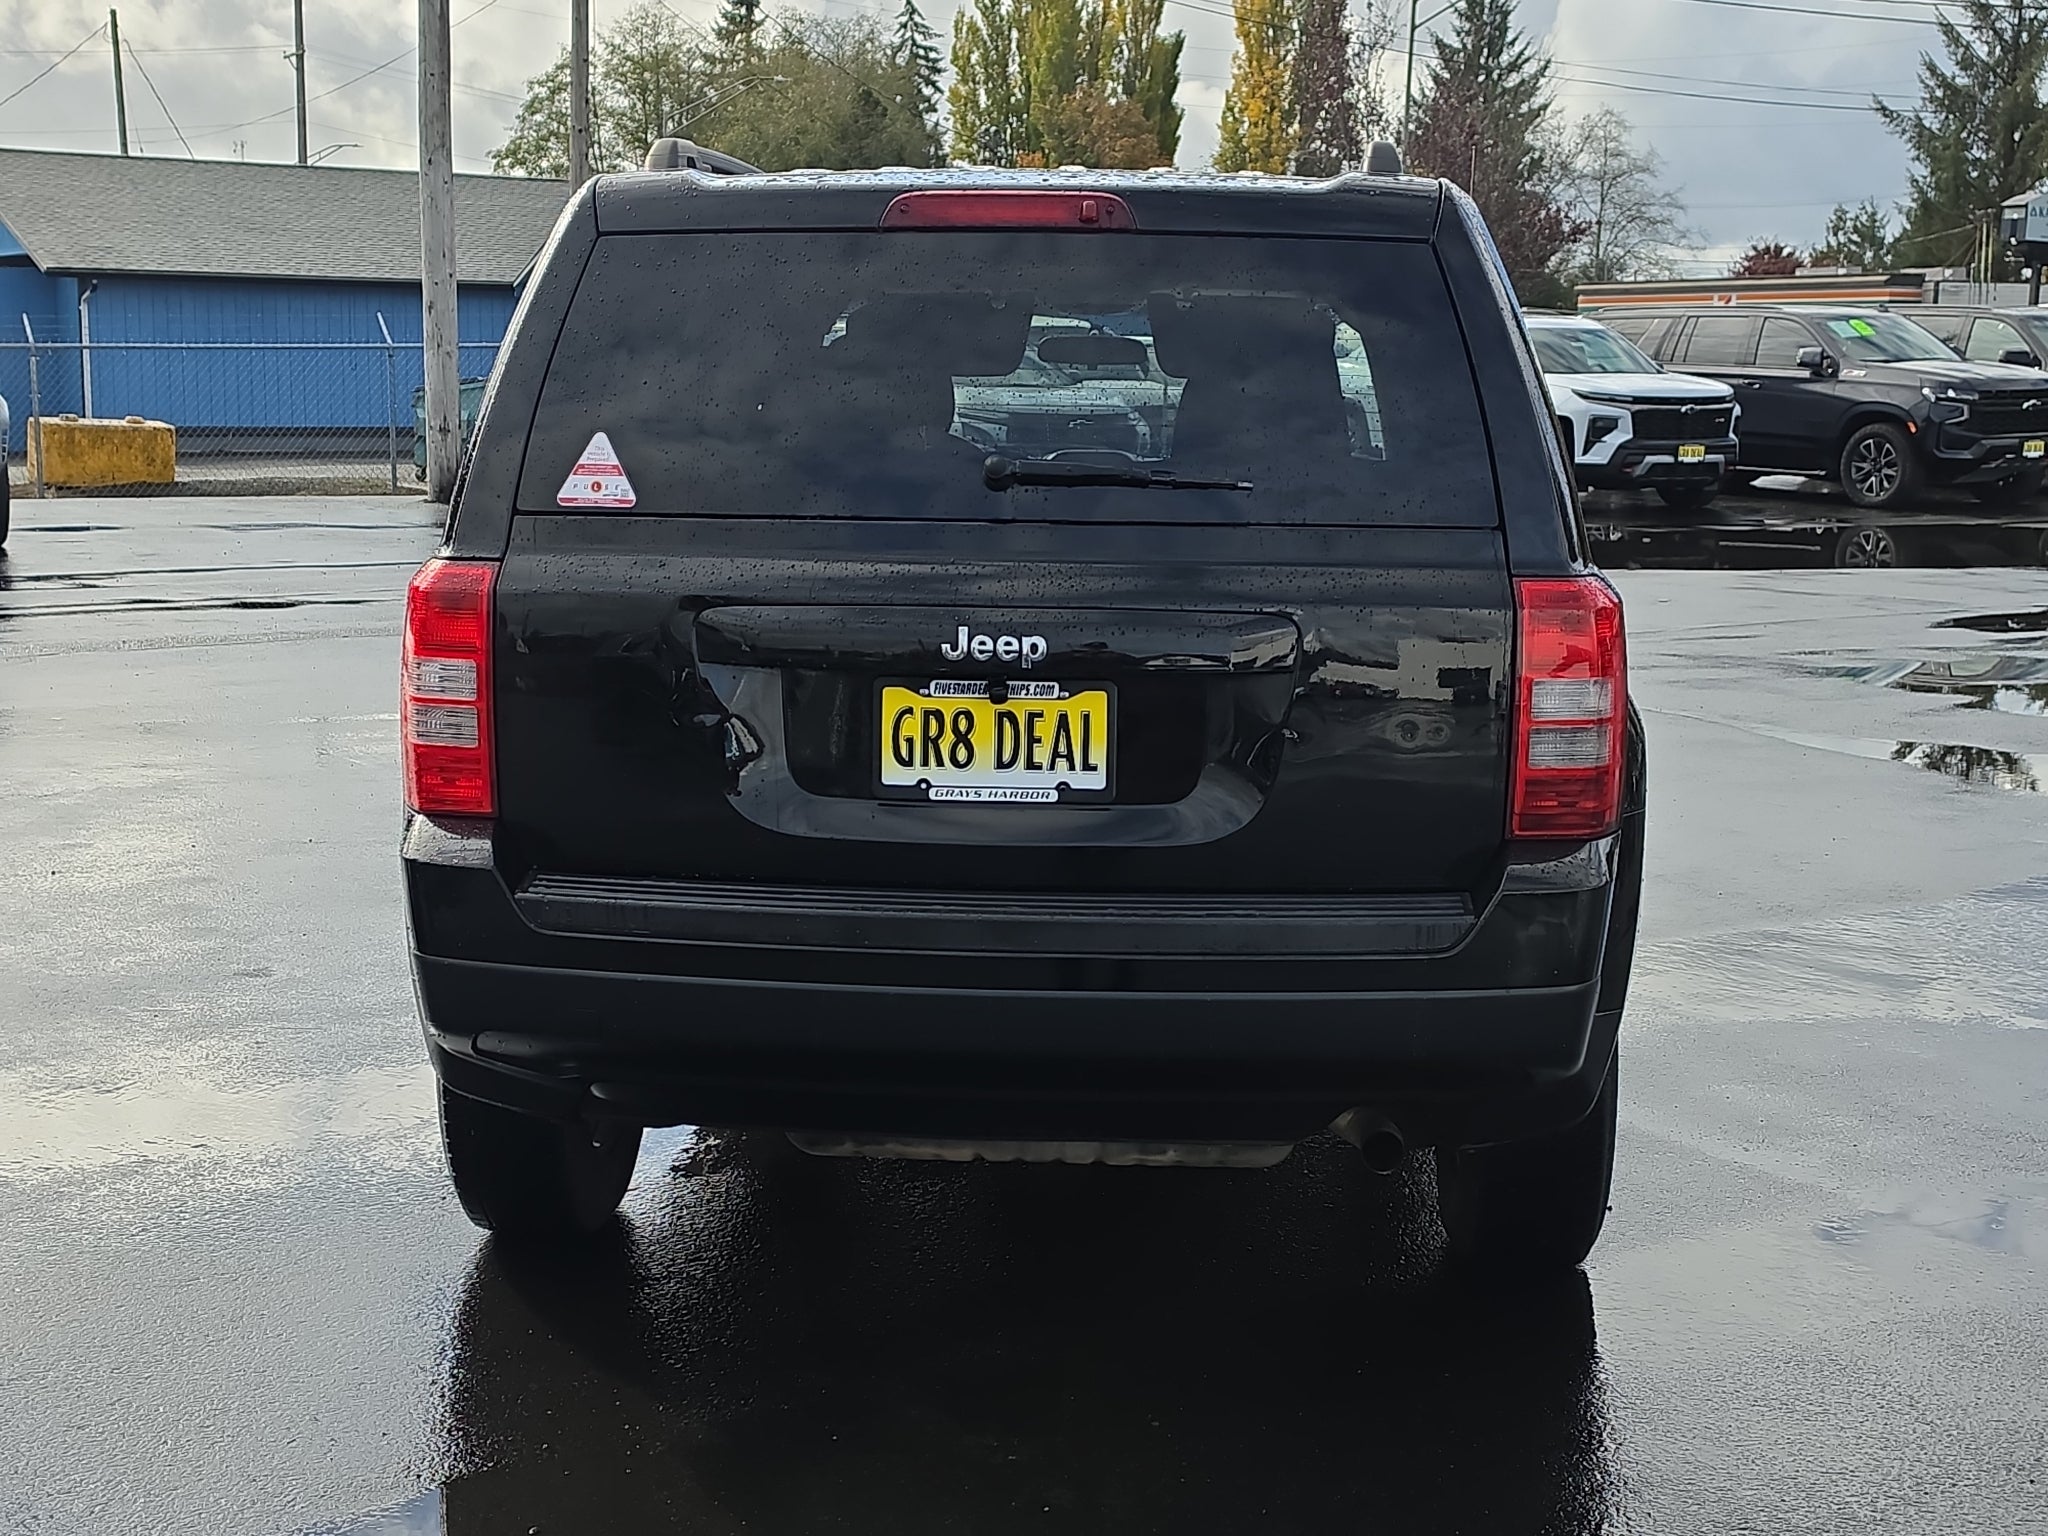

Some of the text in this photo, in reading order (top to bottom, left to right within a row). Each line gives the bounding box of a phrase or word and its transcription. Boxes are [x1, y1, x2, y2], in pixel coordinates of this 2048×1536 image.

[941, 626, 1047, 668] Jeep
[933, 681, 1056, 697] FIVESTARDEAHIPS.COM
[891, 706, 1098, 773] GR8 DEAL
[934, 789, 1051, 800] GRAYS HARBOR
